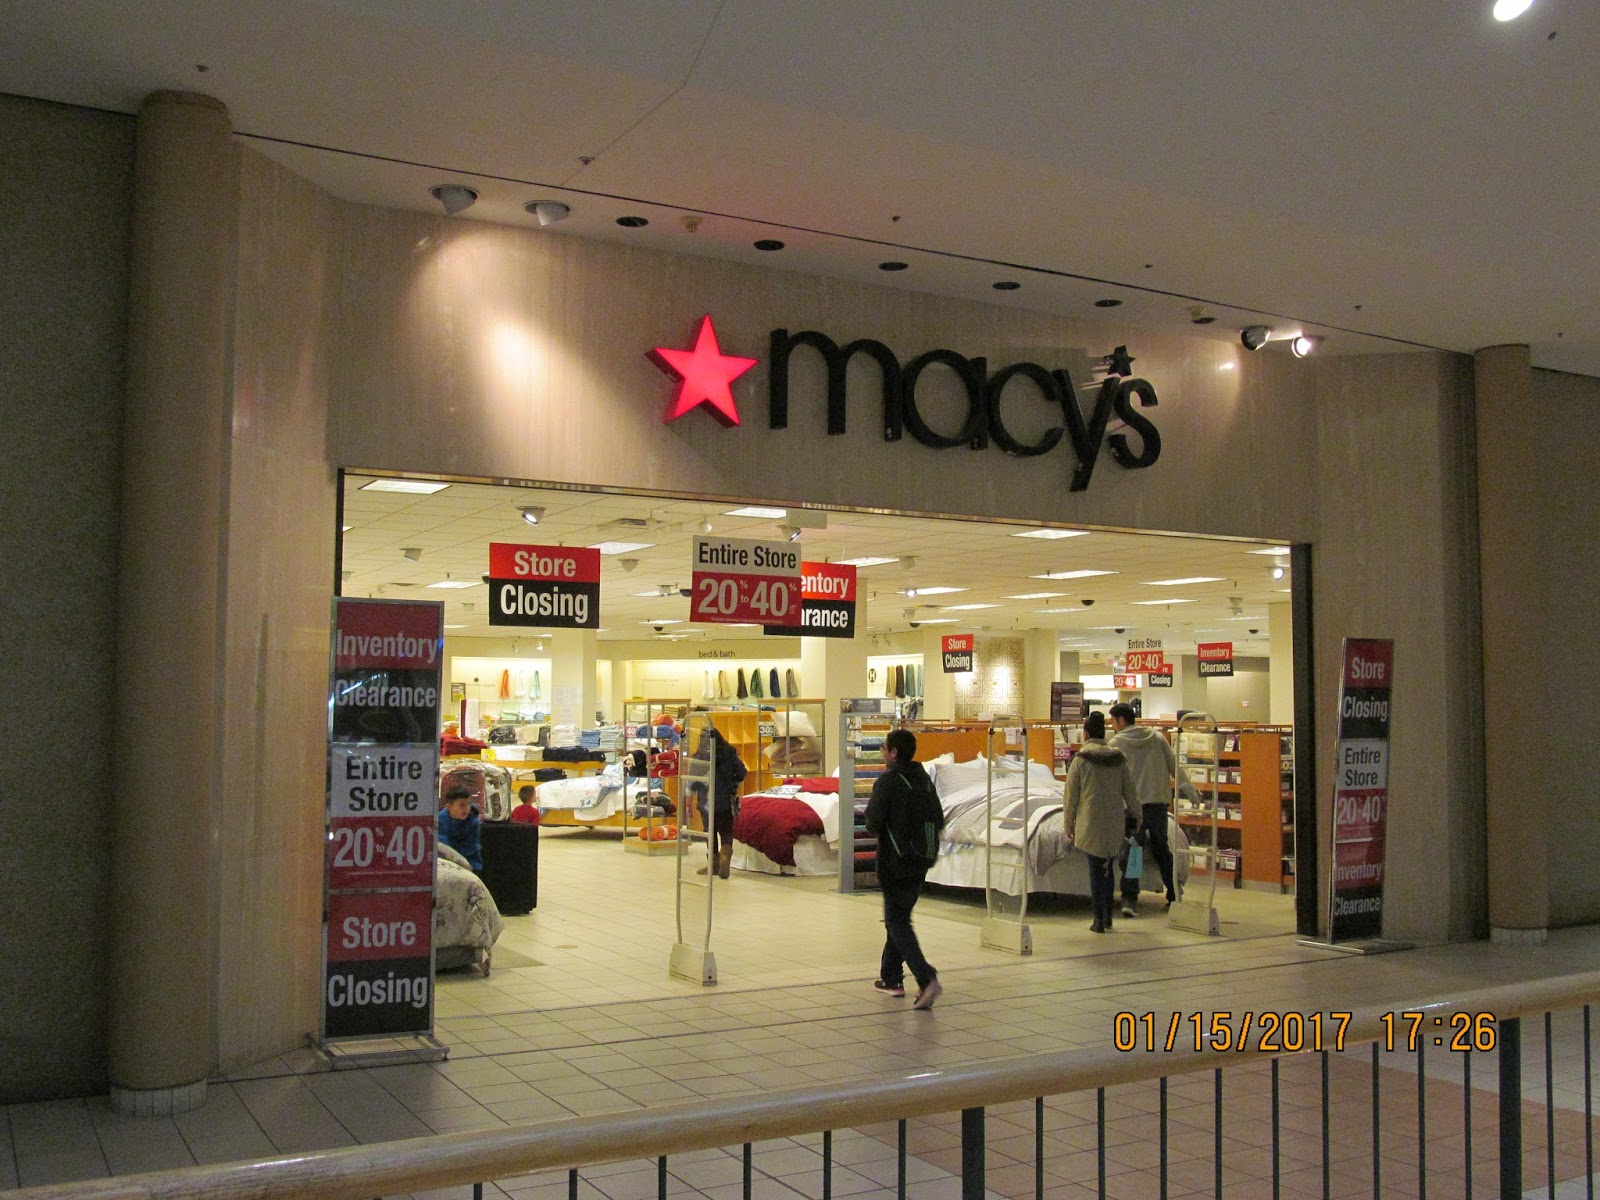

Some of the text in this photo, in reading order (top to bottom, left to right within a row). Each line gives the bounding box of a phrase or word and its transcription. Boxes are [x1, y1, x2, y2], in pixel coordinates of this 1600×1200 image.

[514, 550, 577, 577] Store
[699, 542, 797, 569] Entire Store
[500, 584, 588, 624] Closing
[740, 595, 750, 603] to
[336, 629, 438, 664] Inventory
[948, 638, 967, 650] Store
[1128, 638, 1162, 649] Entire Store
[1200, 647, 1230, 659] Inventory
[698, 650, 736, 658] bed & bath
[944, 653, 970, 671] Closing
[1200, 662, 1231, 673] Clearance
[1351, 657, 1386, 680] Store
[1150, 674, 1171, 687] Closing
[335, 679, 437, 708] Clearance
[1343, 696, 1388, 722] Closing
[1345, 747, 1380, 766] Entire
[346, 755, 422, 780] Entire
[1345, 769, 1378, 786] Store
[349, 786, 418, 812] Store
[375, 843, 385, 854] to
[1334, 897, 1380, 916] Clearance
[342, 916, 417, 949] Store
[327, 972, 428, 1008] Closing
